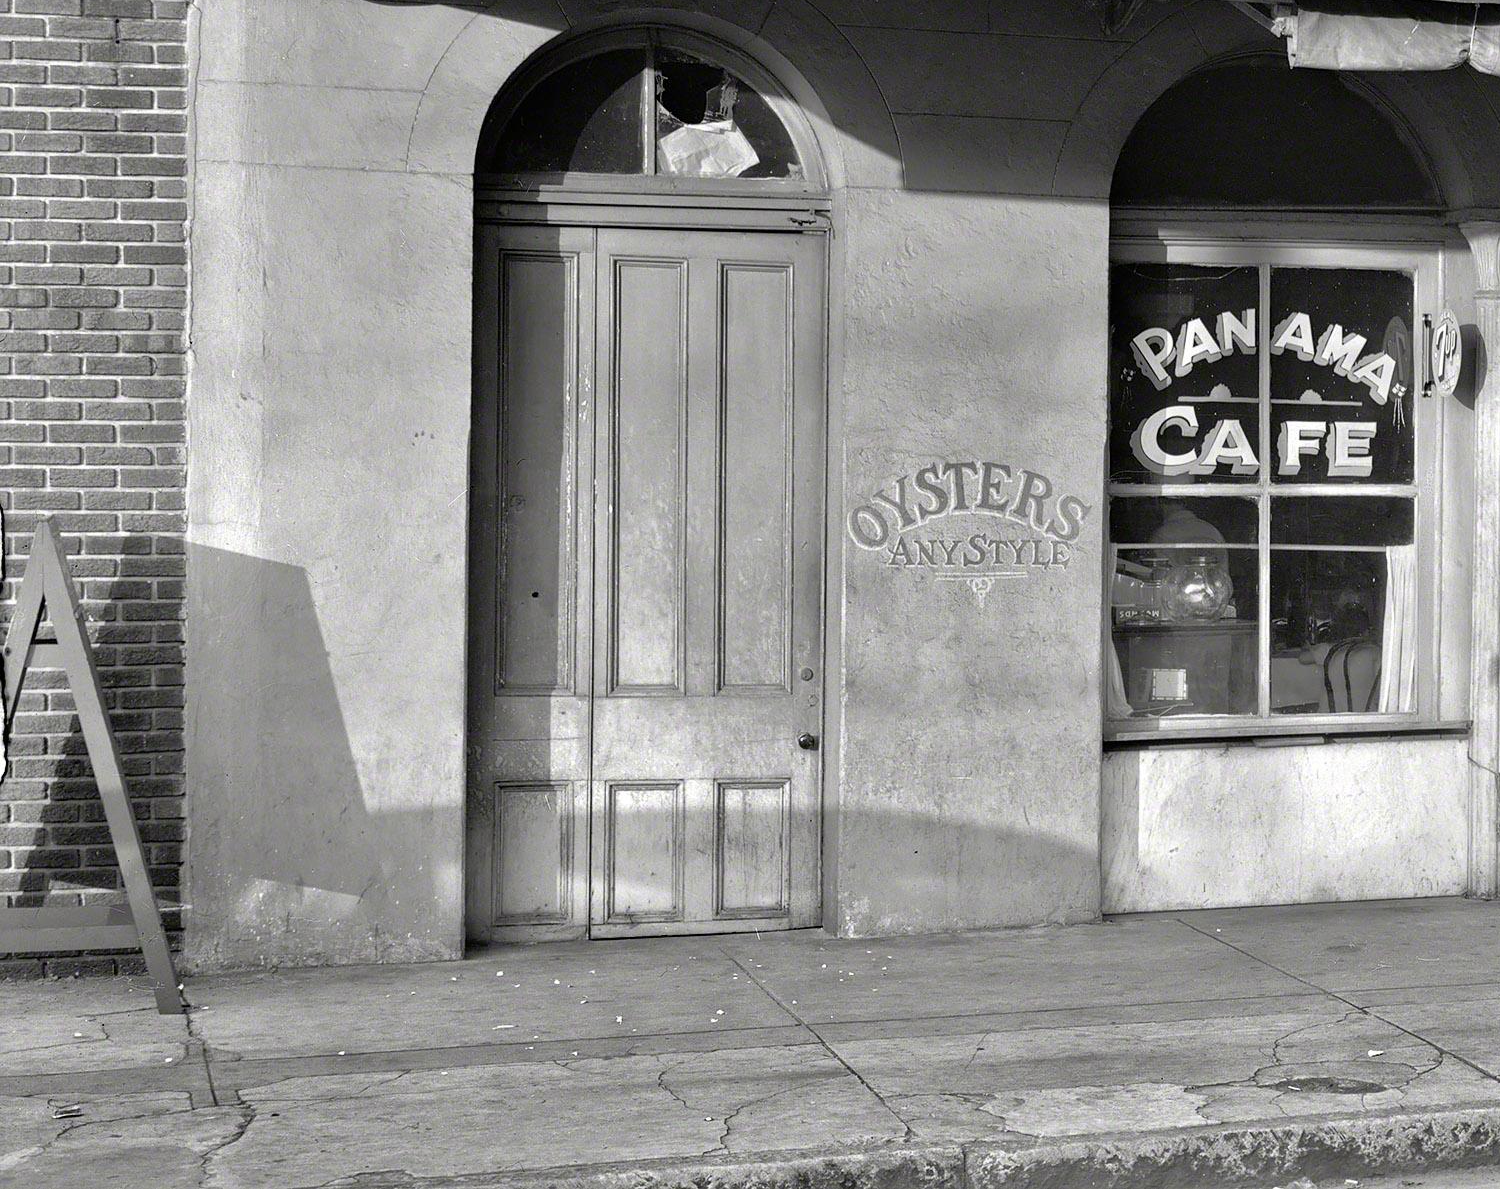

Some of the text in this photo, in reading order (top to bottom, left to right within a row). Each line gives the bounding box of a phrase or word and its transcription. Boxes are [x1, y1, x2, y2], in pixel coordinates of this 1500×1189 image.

[1130, 308, 1397, 406] PANAMA
[1130, 406, 1378, 477] CAFE
[847, 461, 1092, 550] OYSTERS
